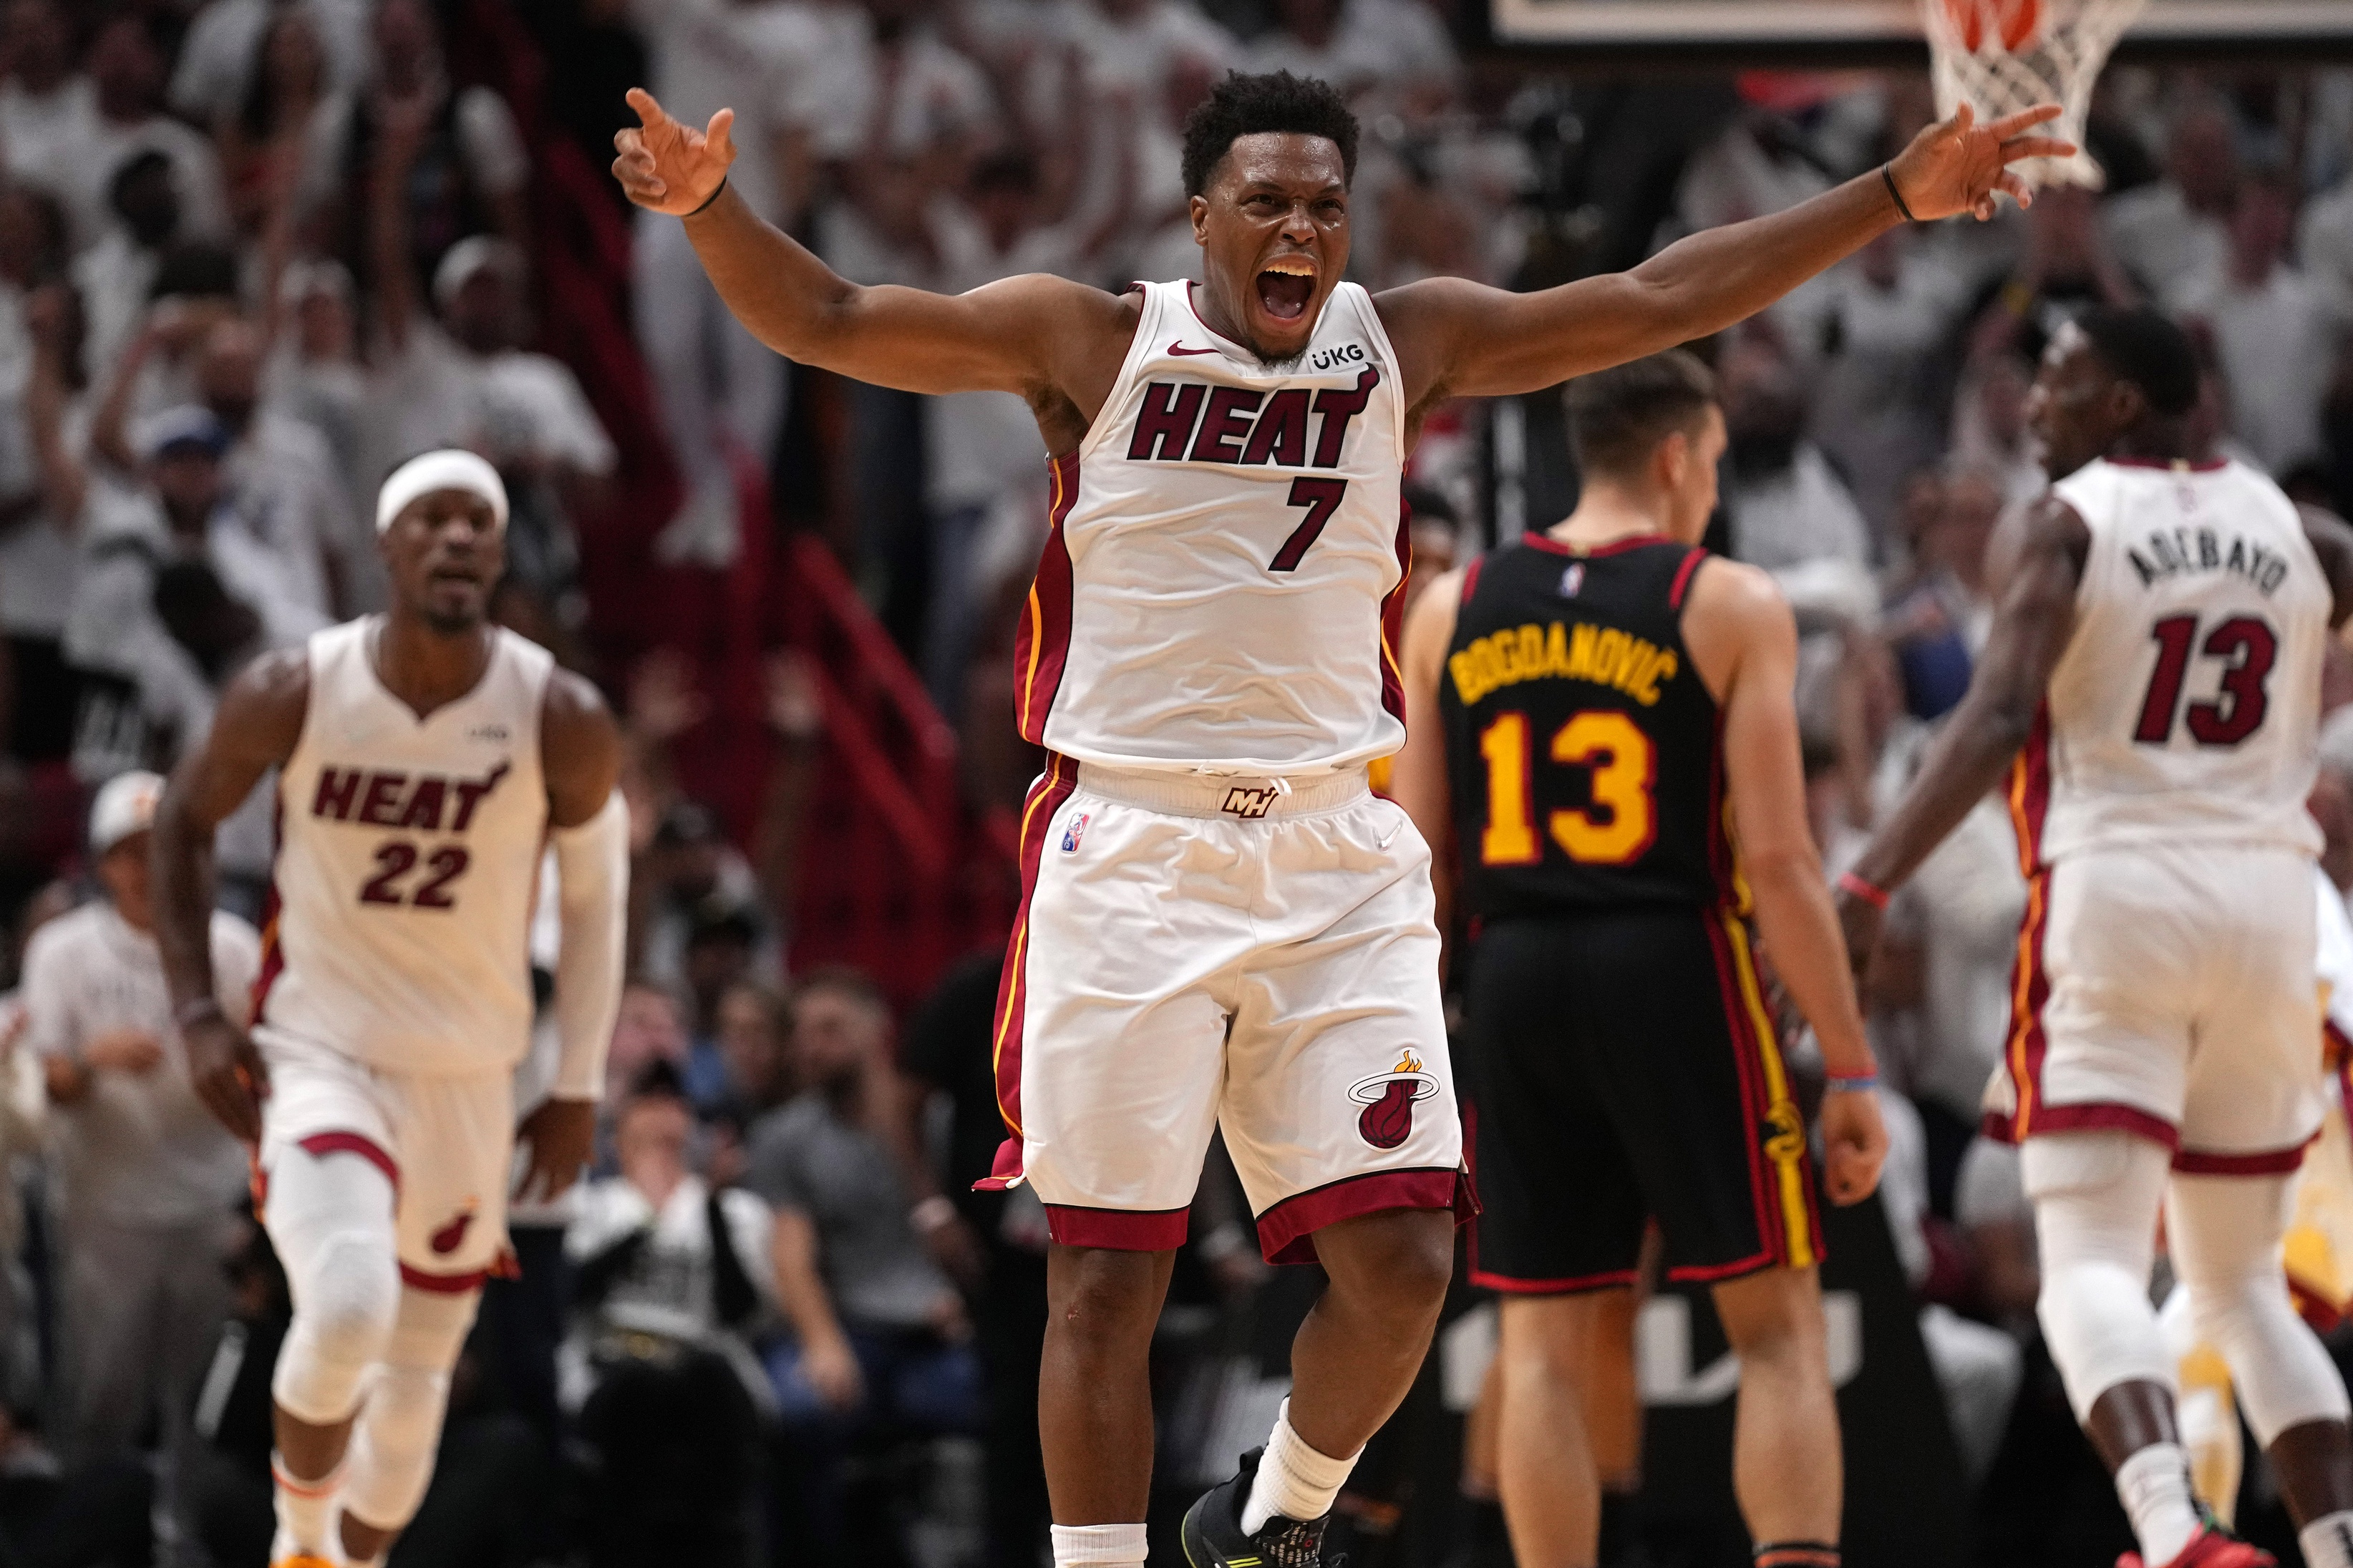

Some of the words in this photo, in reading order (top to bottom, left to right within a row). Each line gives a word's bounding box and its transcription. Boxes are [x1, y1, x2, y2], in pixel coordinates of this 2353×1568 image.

[1127, 362, 1379, 468] HEAT
[1268, 477, 1348, 571] 7
[2133, 611, 2278, 745] 13
[311, 757, 510, 832] HEAT
[1479, 709, 1659, 867] 13
[359, 840, 471, 909] 22
